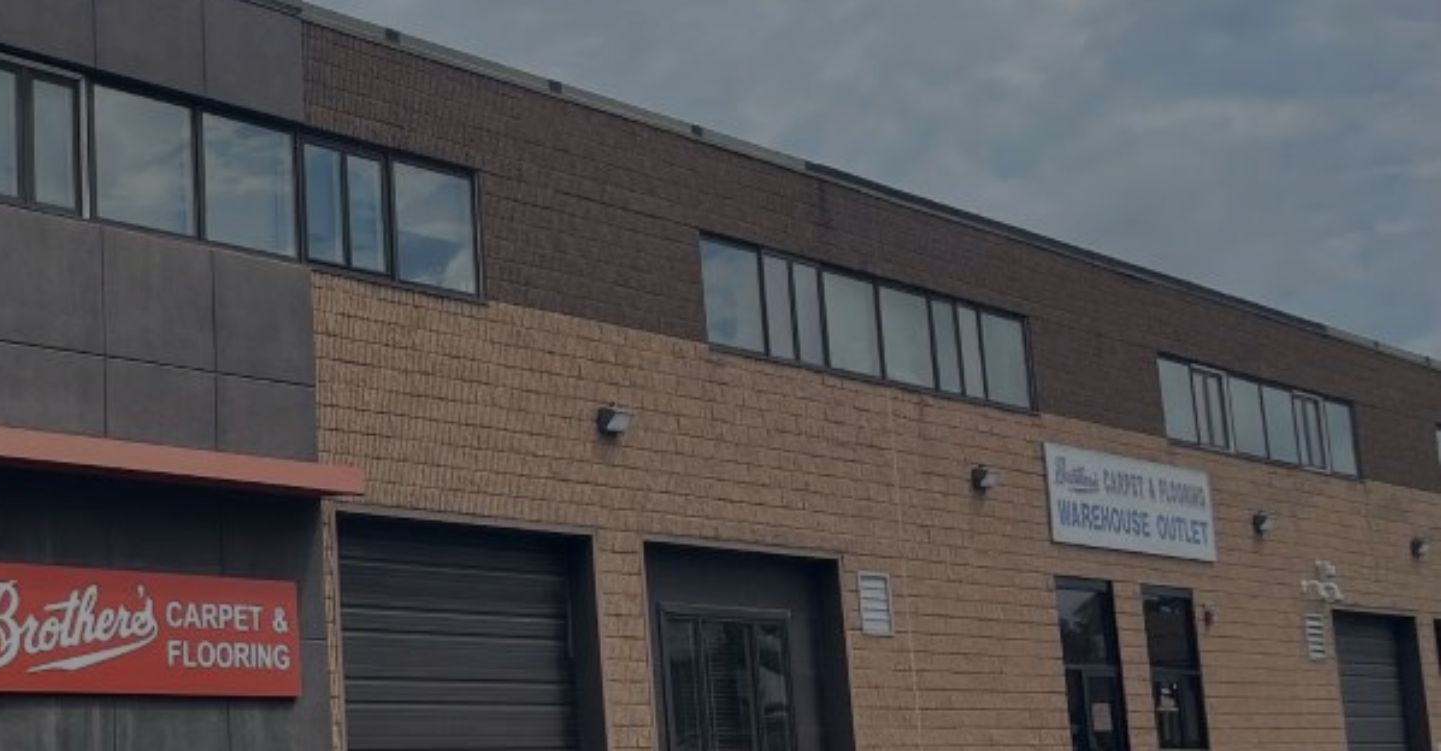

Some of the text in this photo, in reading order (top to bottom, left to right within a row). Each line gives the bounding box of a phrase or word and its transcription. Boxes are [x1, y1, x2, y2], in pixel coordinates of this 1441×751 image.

[1103, 467, 1144, 499] CARPET
[1058, 499, 1209, 546] WAREHOUSE OUTLET
[166, 601, 263, 632] CARPET
[272, 606, 288, 633] &
[167, 639, 290, 670] FLOORING
